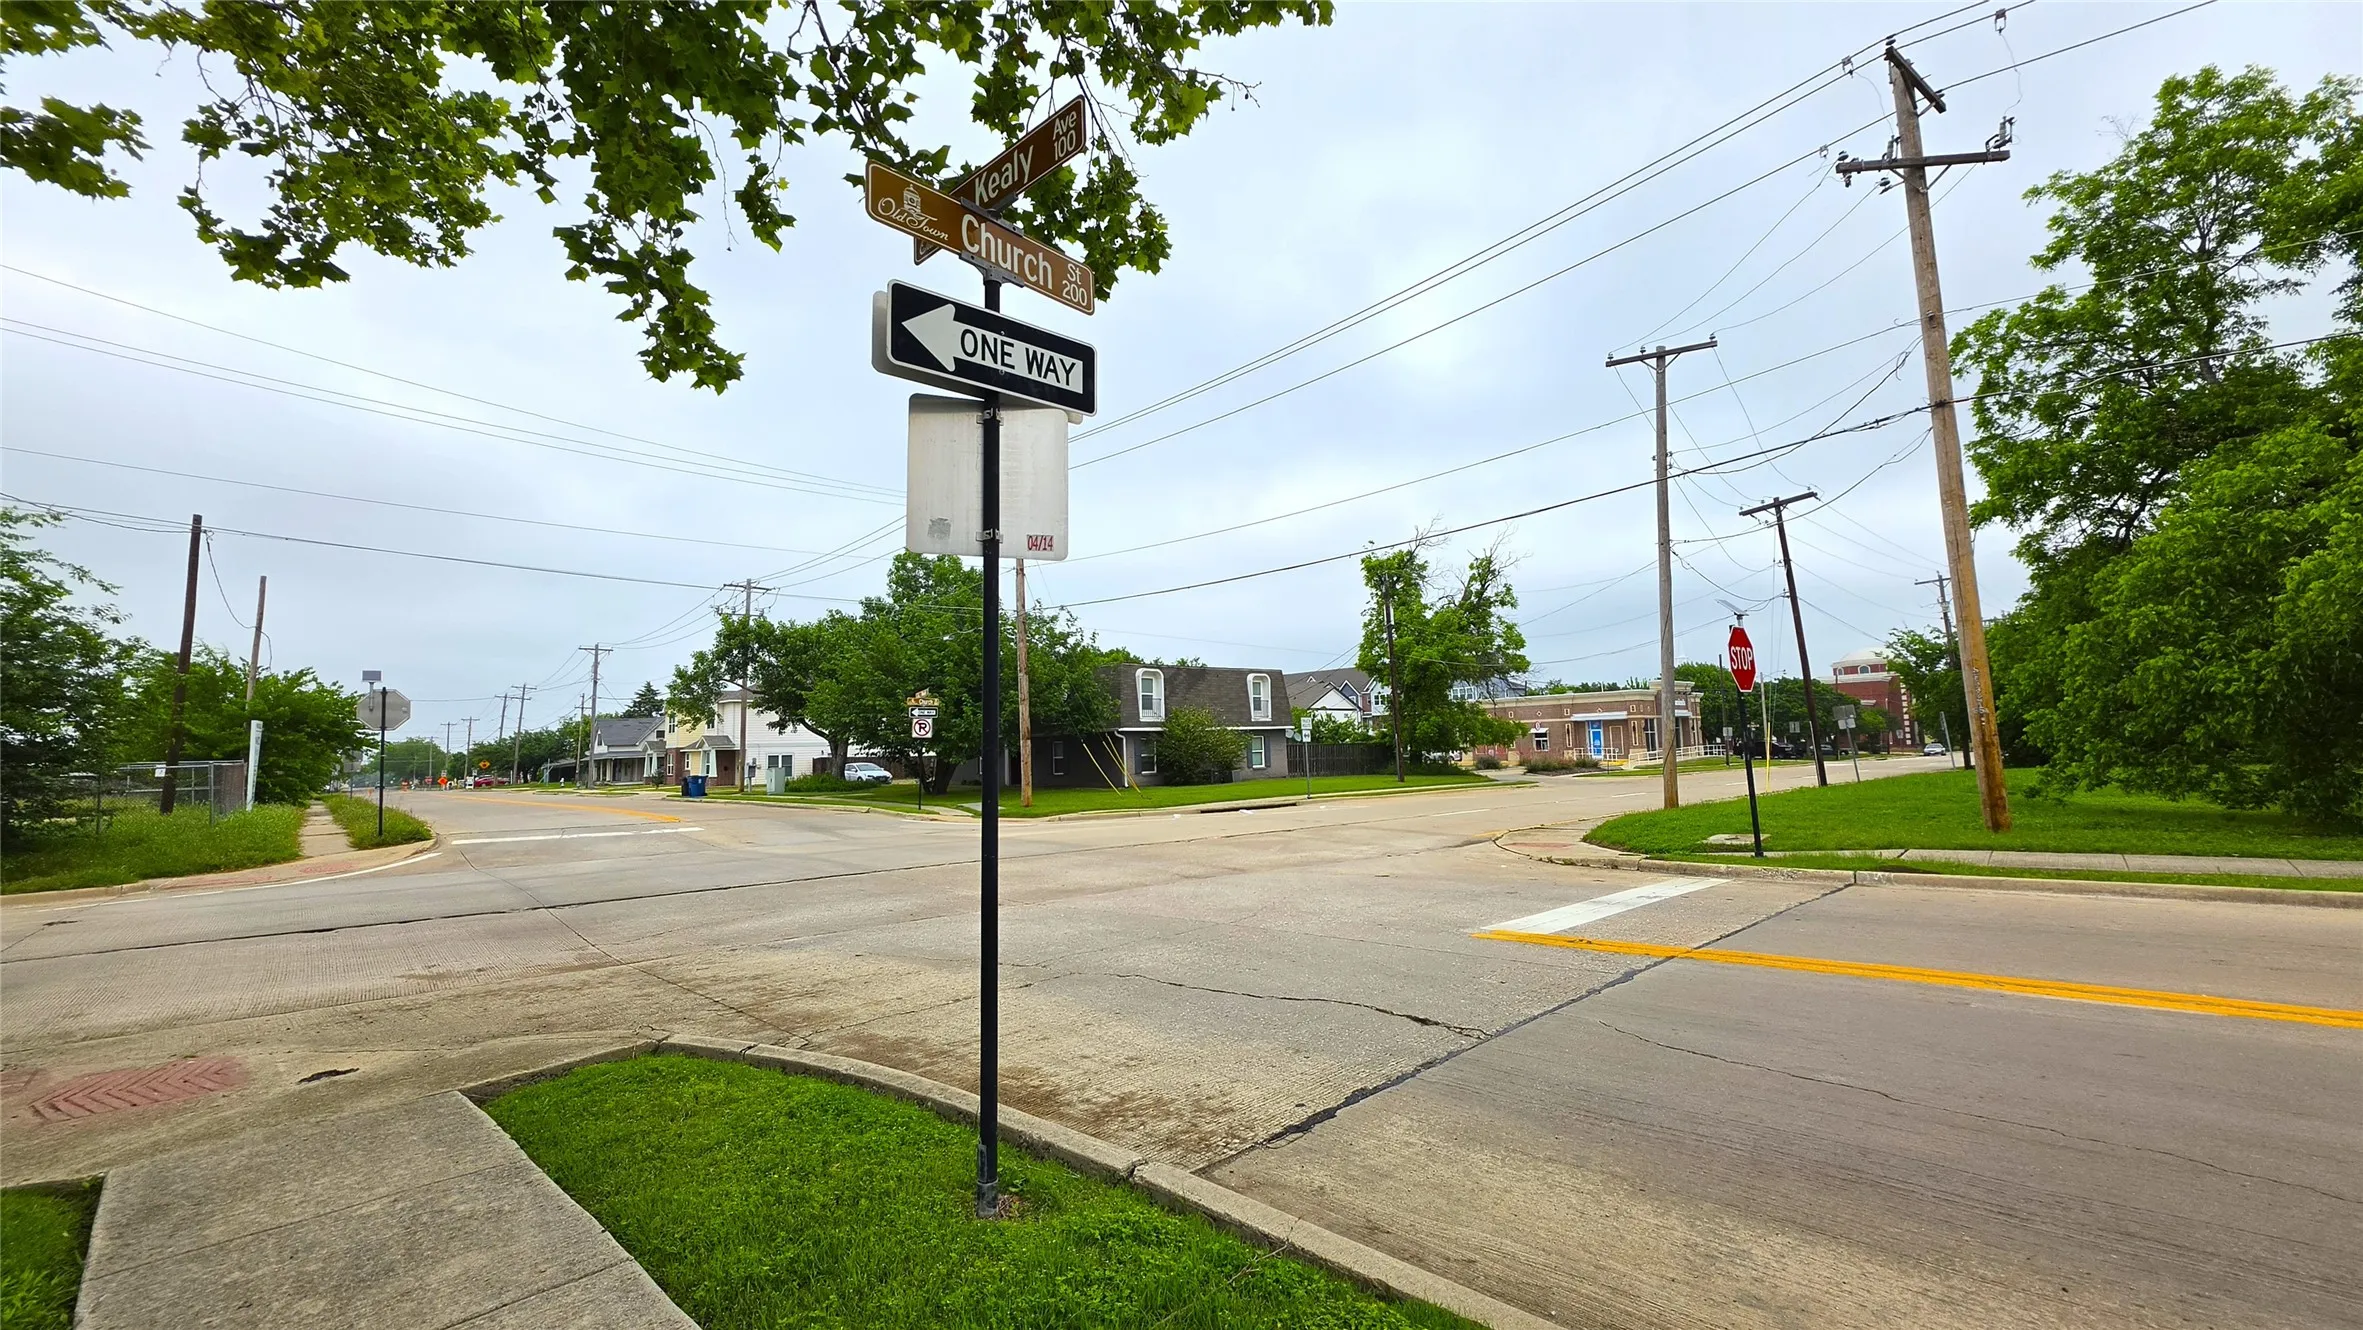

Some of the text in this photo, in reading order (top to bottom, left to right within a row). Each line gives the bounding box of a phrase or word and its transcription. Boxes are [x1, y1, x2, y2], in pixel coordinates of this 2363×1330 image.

[975, 111, 1077, 206] Kealy Ave
[1054, 130, 1076, 161] 100
[878, 197, 949, 241] Old Town
[961, 213, 1082, 290] Church St
[1062, 280, 1088, 307] 200
[960, 328, 1076, 386] ONE WAY
[1027, 535, 1054, 551] 04/14
[1731, 646, 1753, 670] STOP
